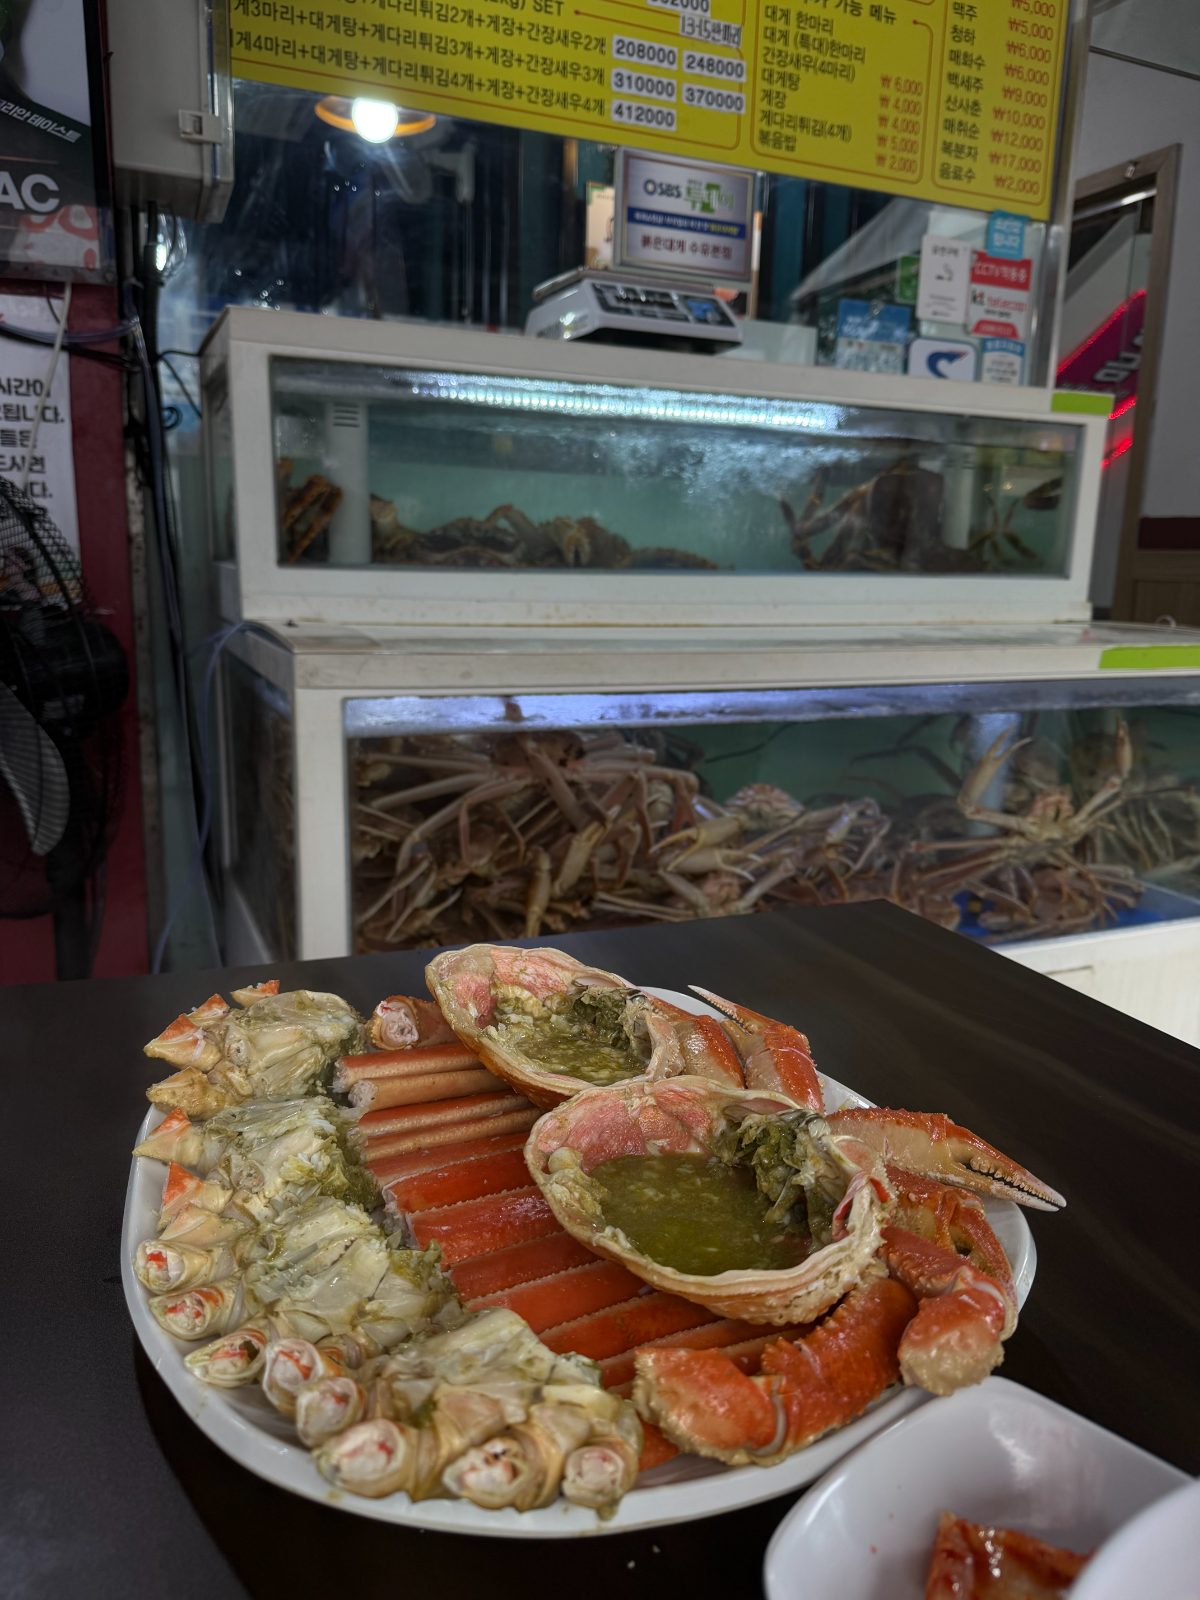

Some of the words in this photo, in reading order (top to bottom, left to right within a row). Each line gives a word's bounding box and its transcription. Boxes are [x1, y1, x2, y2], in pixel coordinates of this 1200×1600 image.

[764, 4, 791, 26] 대게
[796, 10, 834, 36] 한마리
[953, 1, 978, 21] 맥주
[763, 26, 790, 48] 대게
[950, 24, 976, 46] 청하
[615, 38, 676, 66] 208000
[685, 54, 744, 78] 248000
[230, 28, 605, 116] 게4마리+대게탕+게다리튀김4개+게장+간장새우4개
[614, 104, 675, 127] 412000
[614, 72, 675, 98] 310000
[685, 87, 744, 111] 370000
[0, 99, 31, 121] 리안
[27, 114, 82, 143] 테이스트
[0, 403, 65, 424] 됩니다.
